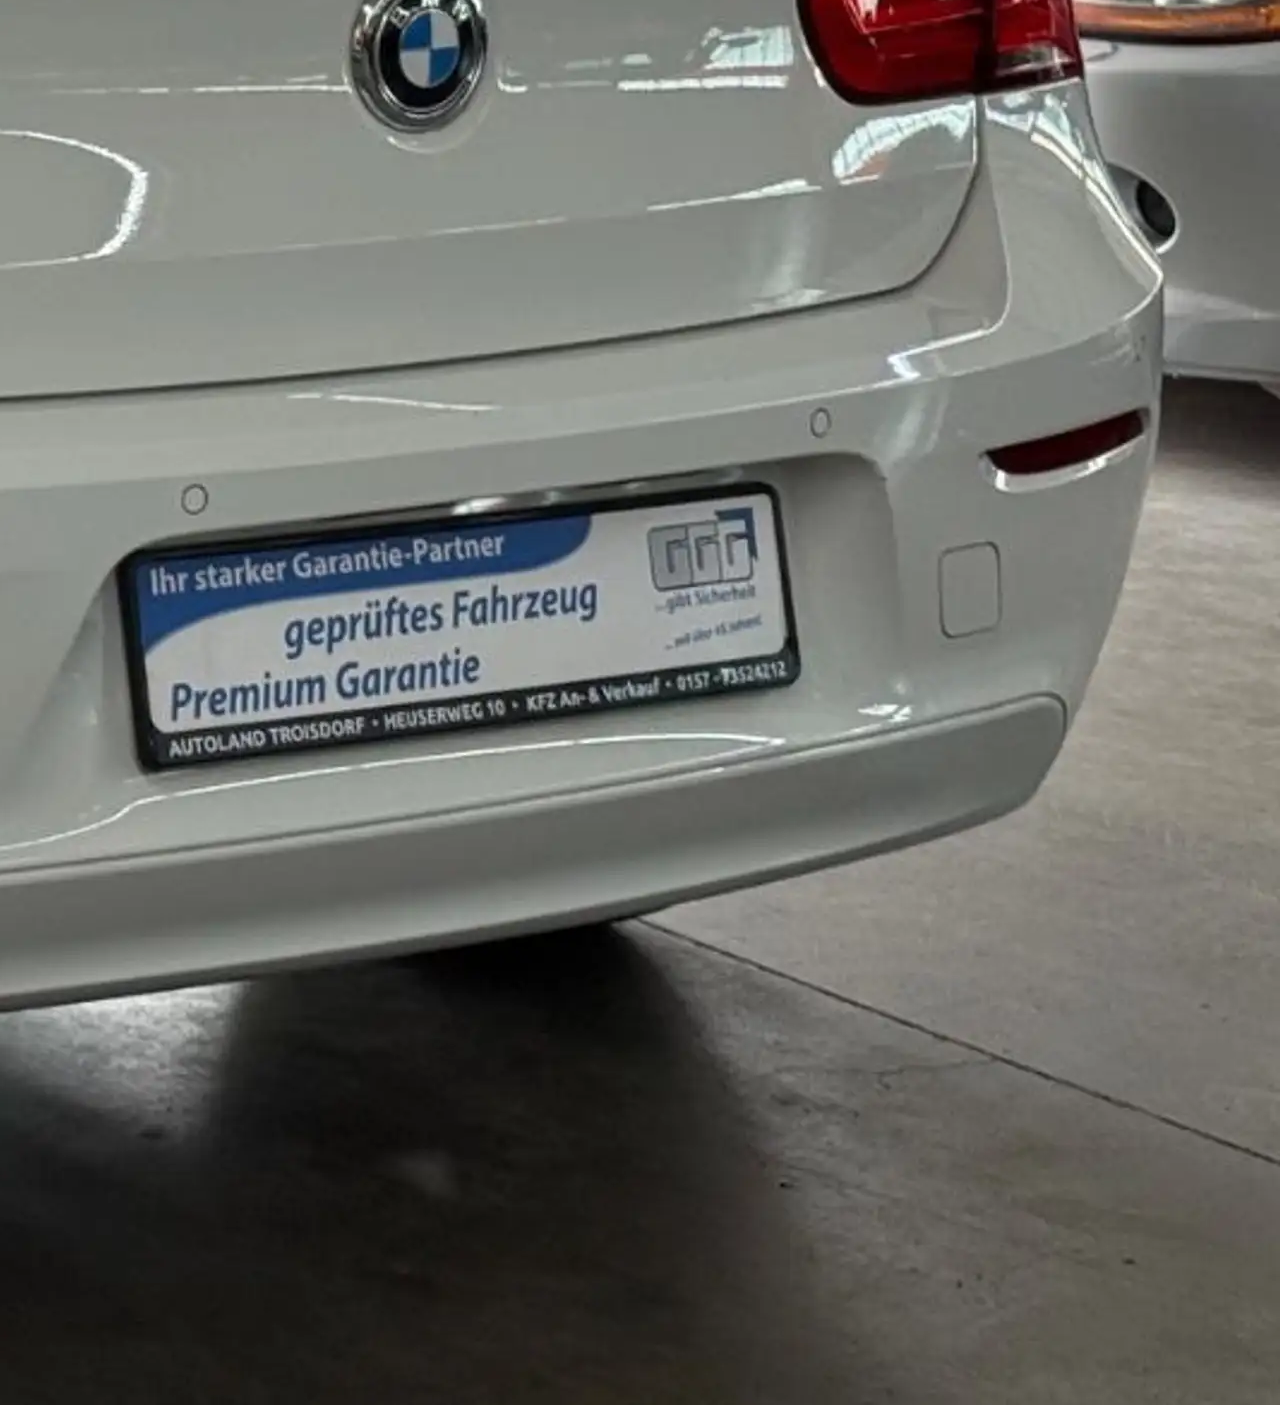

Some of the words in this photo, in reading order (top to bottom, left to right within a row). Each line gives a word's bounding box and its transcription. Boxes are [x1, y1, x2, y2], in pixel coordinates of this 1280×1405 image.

[150, 567, 188, 596] Ihr
[195, 557, 286, 592] starker
[293, 535, 505, 579] Garantie-Partner
[284, 596, 444, 660] geprüftes
[452, 583, 599, 628] Fahrzeug
[168, 729, 267, 759] AUTOLAND
[270, 715, 366, 746] TROISDORF
[384, 700, 484, 731] HEUSERWEG
[487, 698, 507, 718] 10
[526, 693, 557, 713] KFZ
[602, 678, 661, 703] Verkauf
[171, 672, 327, 722] Premium
[336, 648, 481, 700] Garantie
